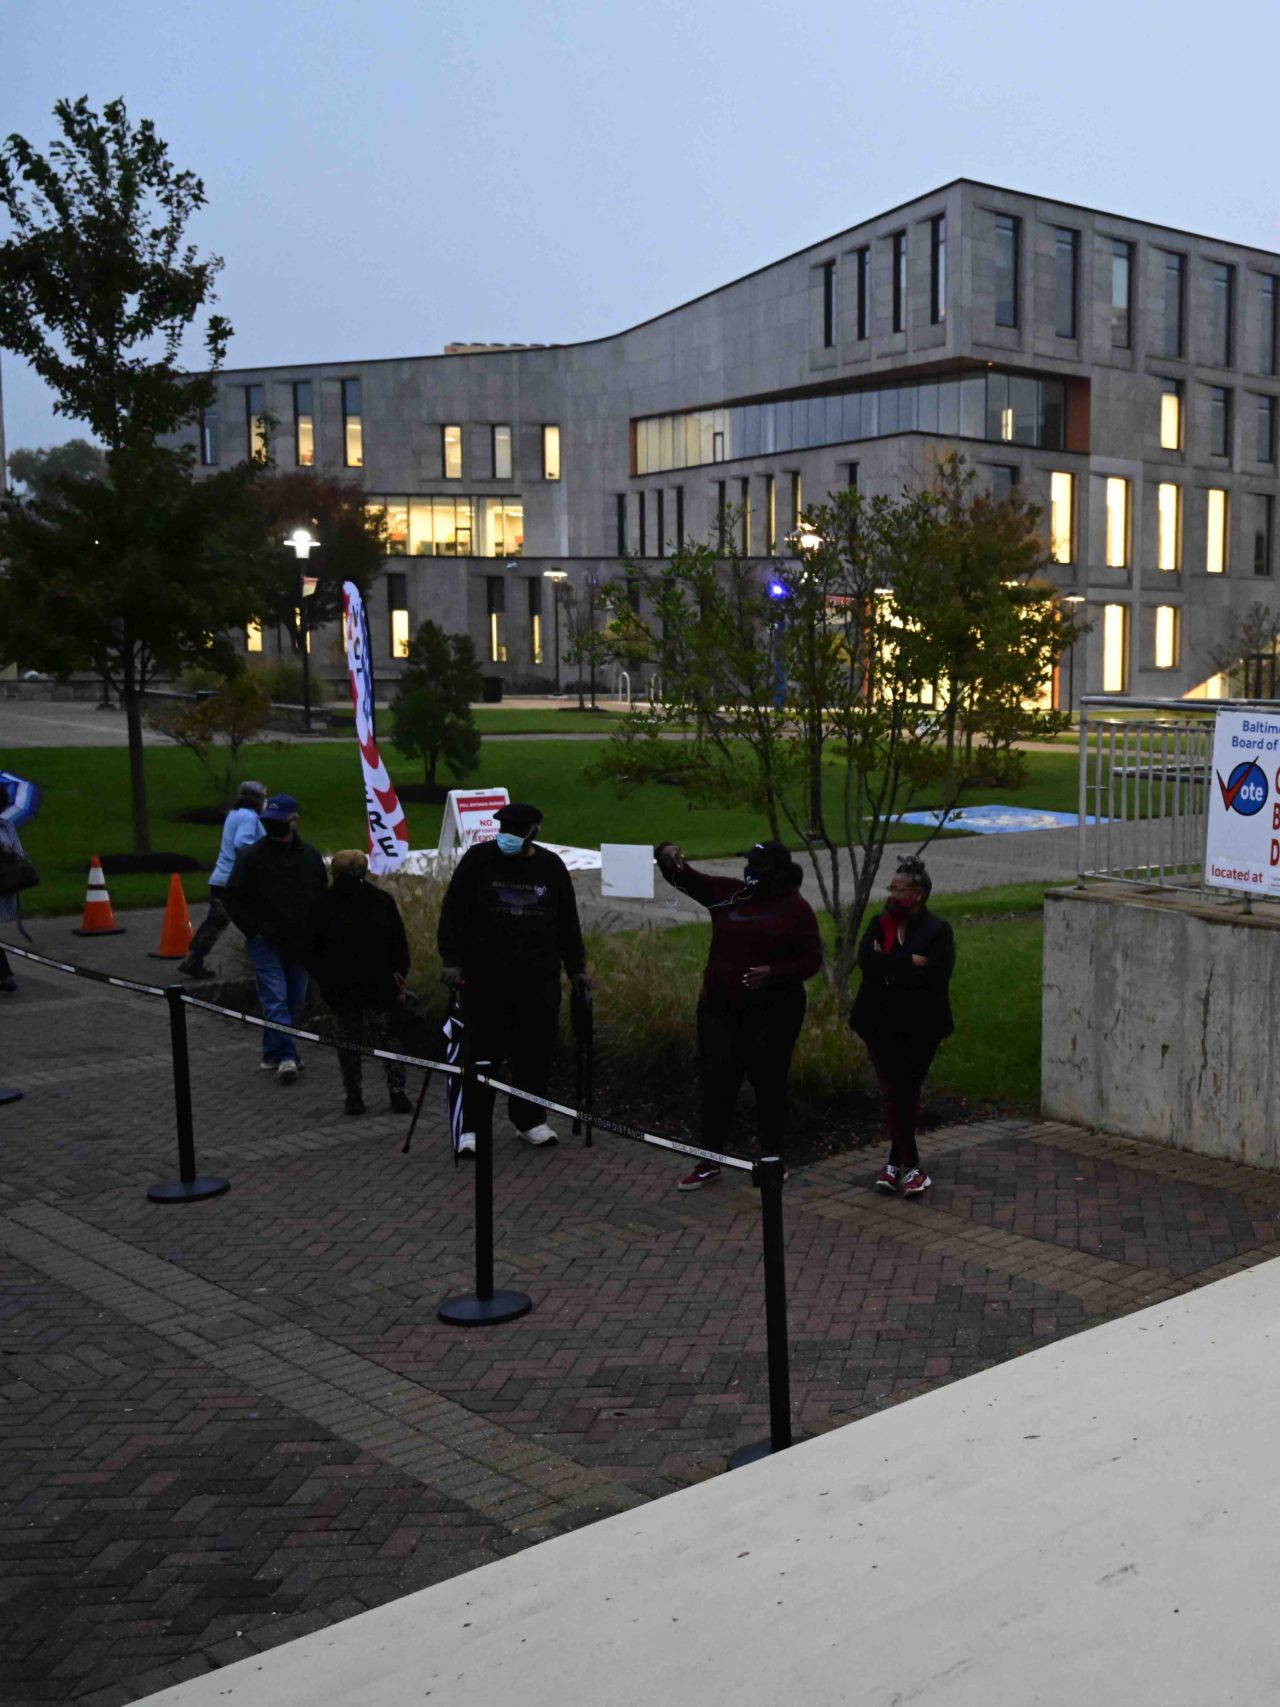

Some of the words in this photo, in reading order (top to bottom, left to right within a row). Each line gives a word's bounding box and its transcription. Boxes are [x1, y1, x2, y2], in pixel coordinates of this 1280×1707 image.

[1232, 735, 1264, 750] Board
[1266, 739, 1279, 751] of
[1211, 865, 1250, 882] located
[1251, 870, 1263, 884] at
[576, 1111, 593, 1122] KEEP
[593, 1116, 612, 1130] YOUR
